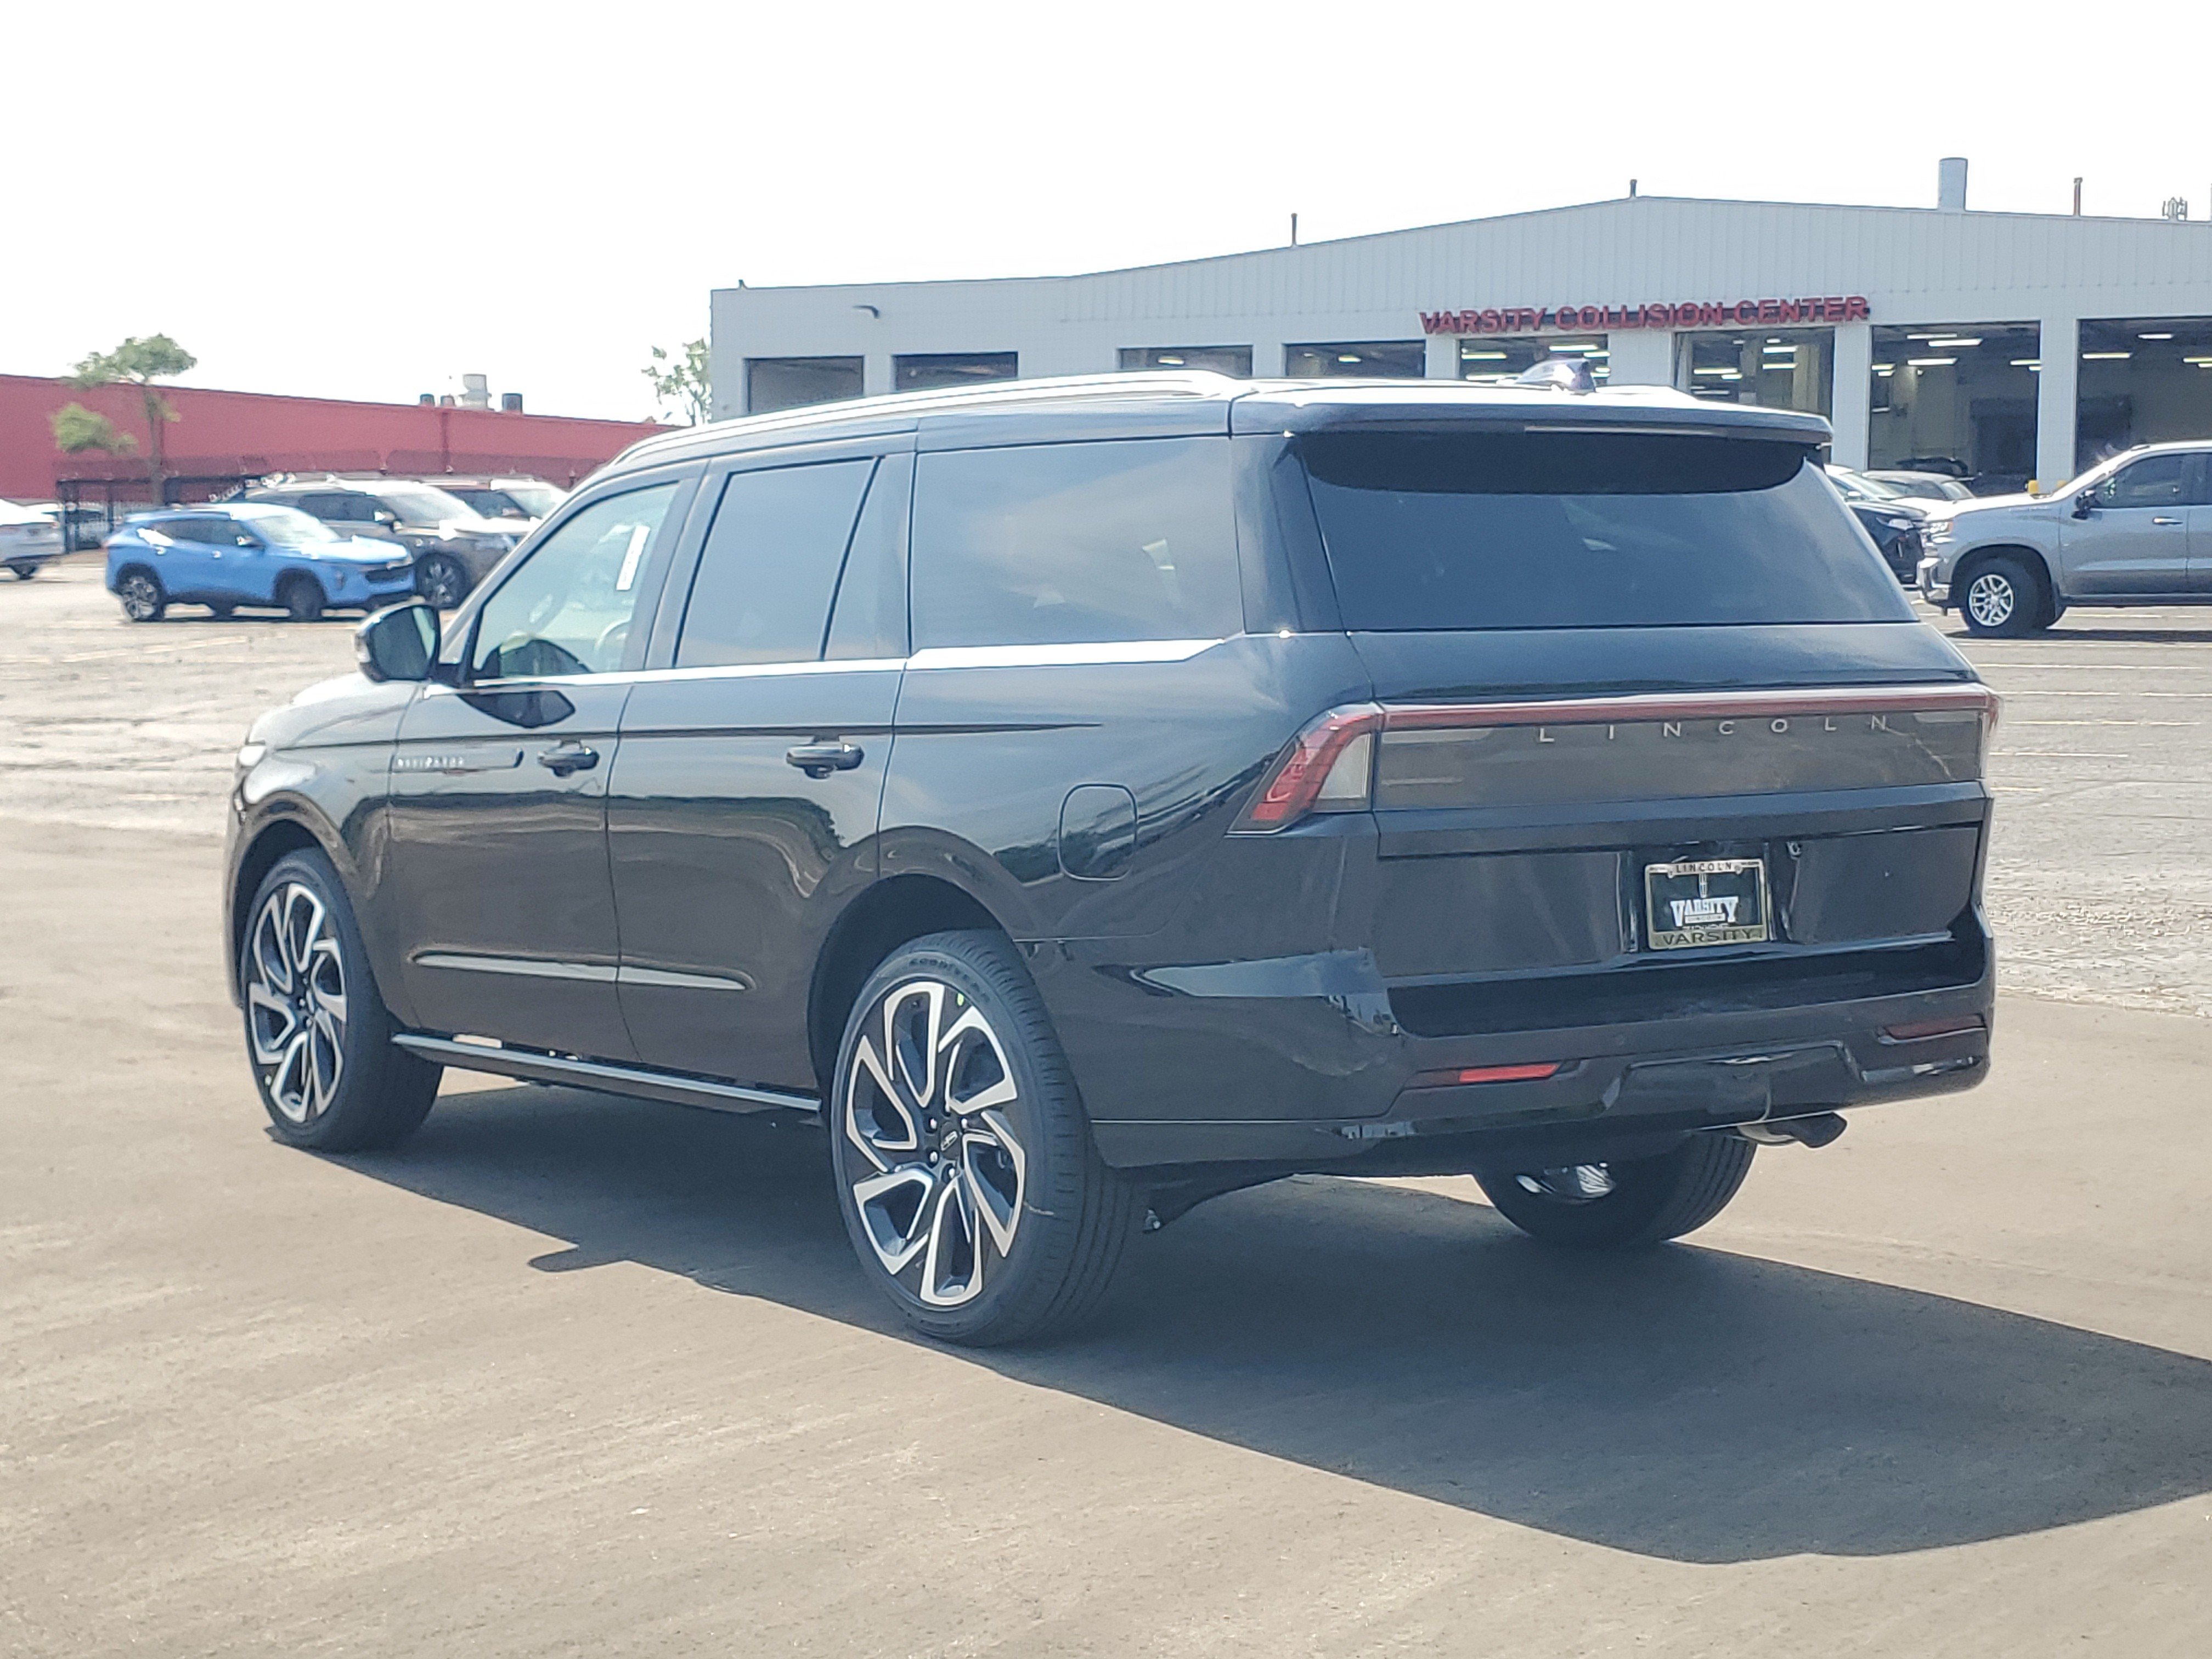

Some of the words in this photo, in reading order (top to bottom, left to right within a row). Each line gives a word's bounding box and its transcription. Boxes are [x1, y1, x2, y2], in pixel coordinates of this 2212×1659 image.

[1419, 307, 1547, 334] VARSITY
[1555, 303, 1723, 330] COLLISION
[1734, 296, 1868, 325] CENTER
[1539, 715, 1886, 742] LINCOLN
[1676, 862, 1731, 873] LINCOLN
[1670, 896, 1739, 926] VARSITY
[1663, 929, 1752, 945] VARSITY
